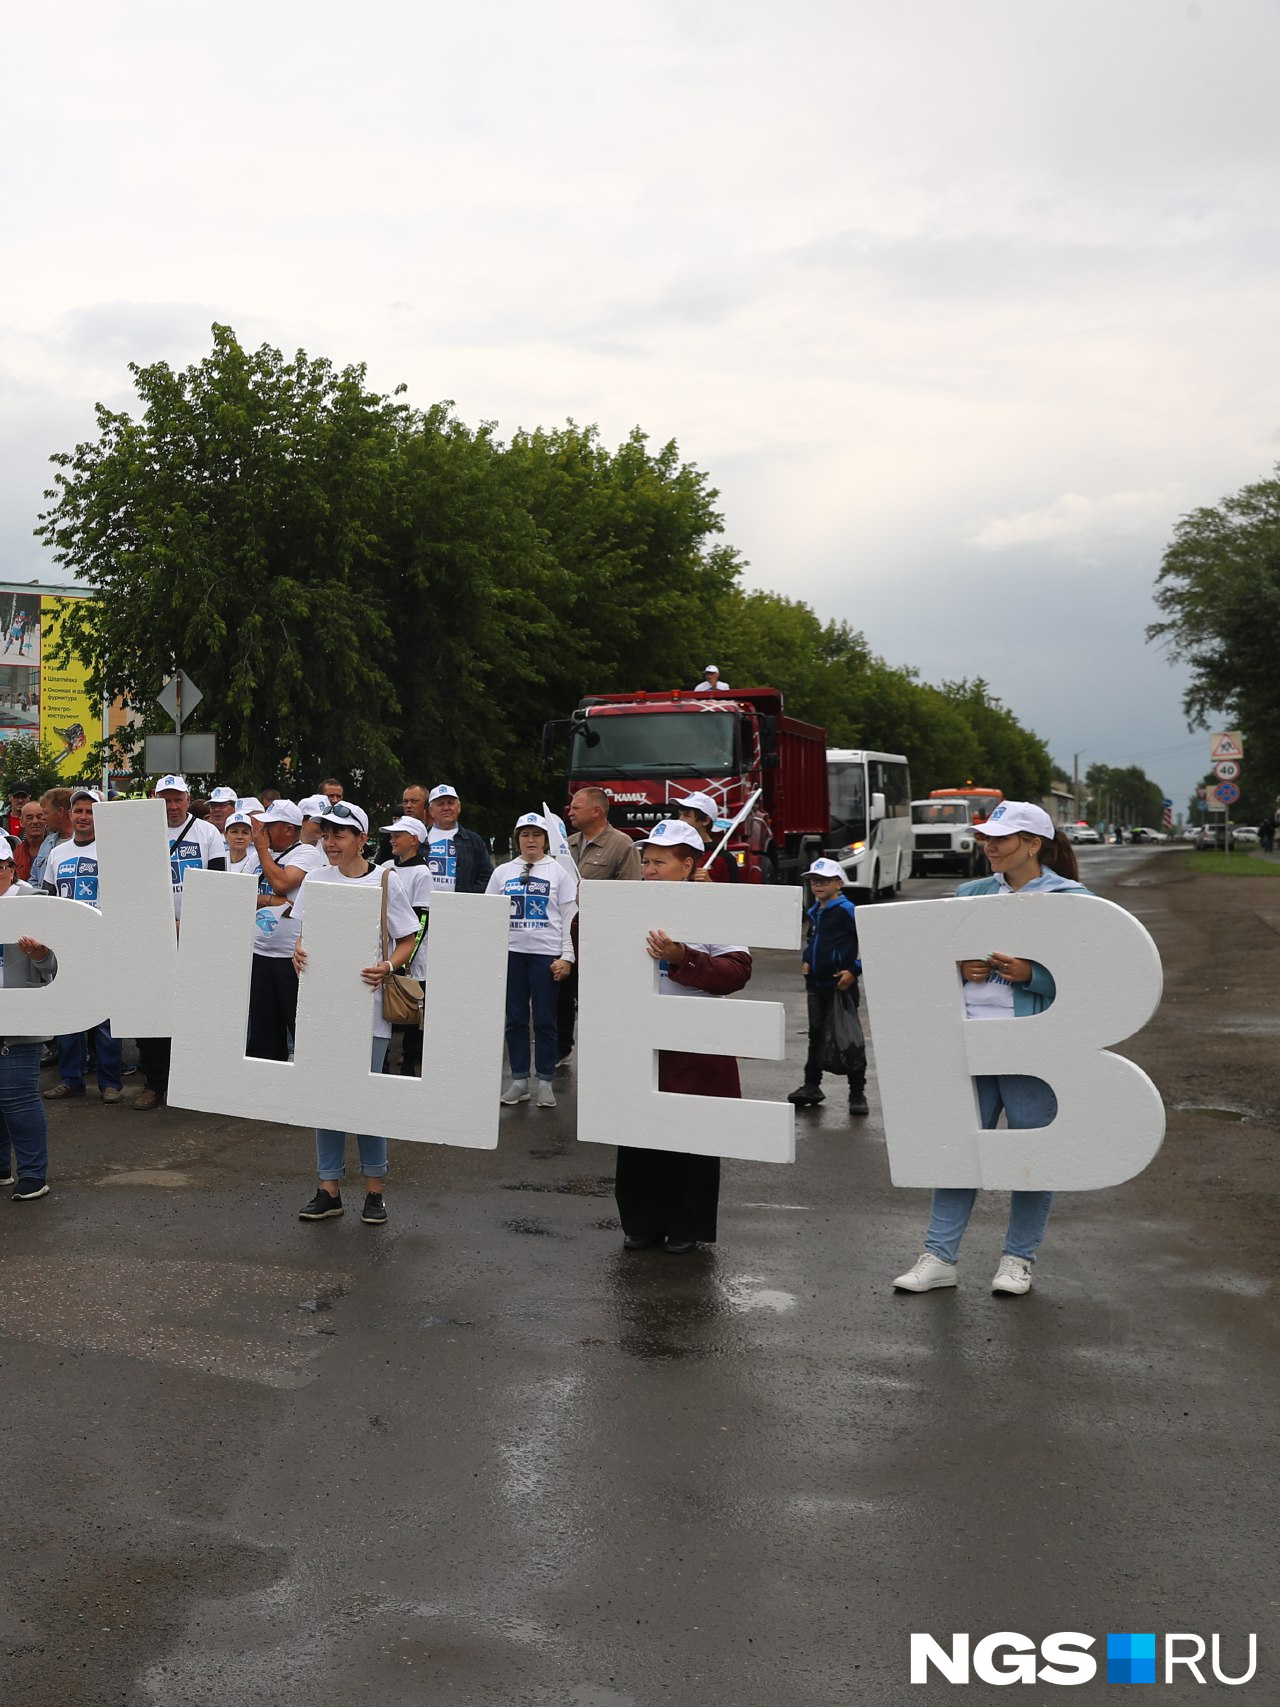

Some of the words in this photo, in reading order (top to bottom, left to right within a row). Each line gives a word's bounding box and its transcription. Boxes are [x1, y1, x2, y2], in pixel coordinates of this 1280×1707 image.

[1220, 766, 1235, 775] 40
[614, 793, 647, 802] KAMAZ
[627, 813, 672, 821] KAMAZ
